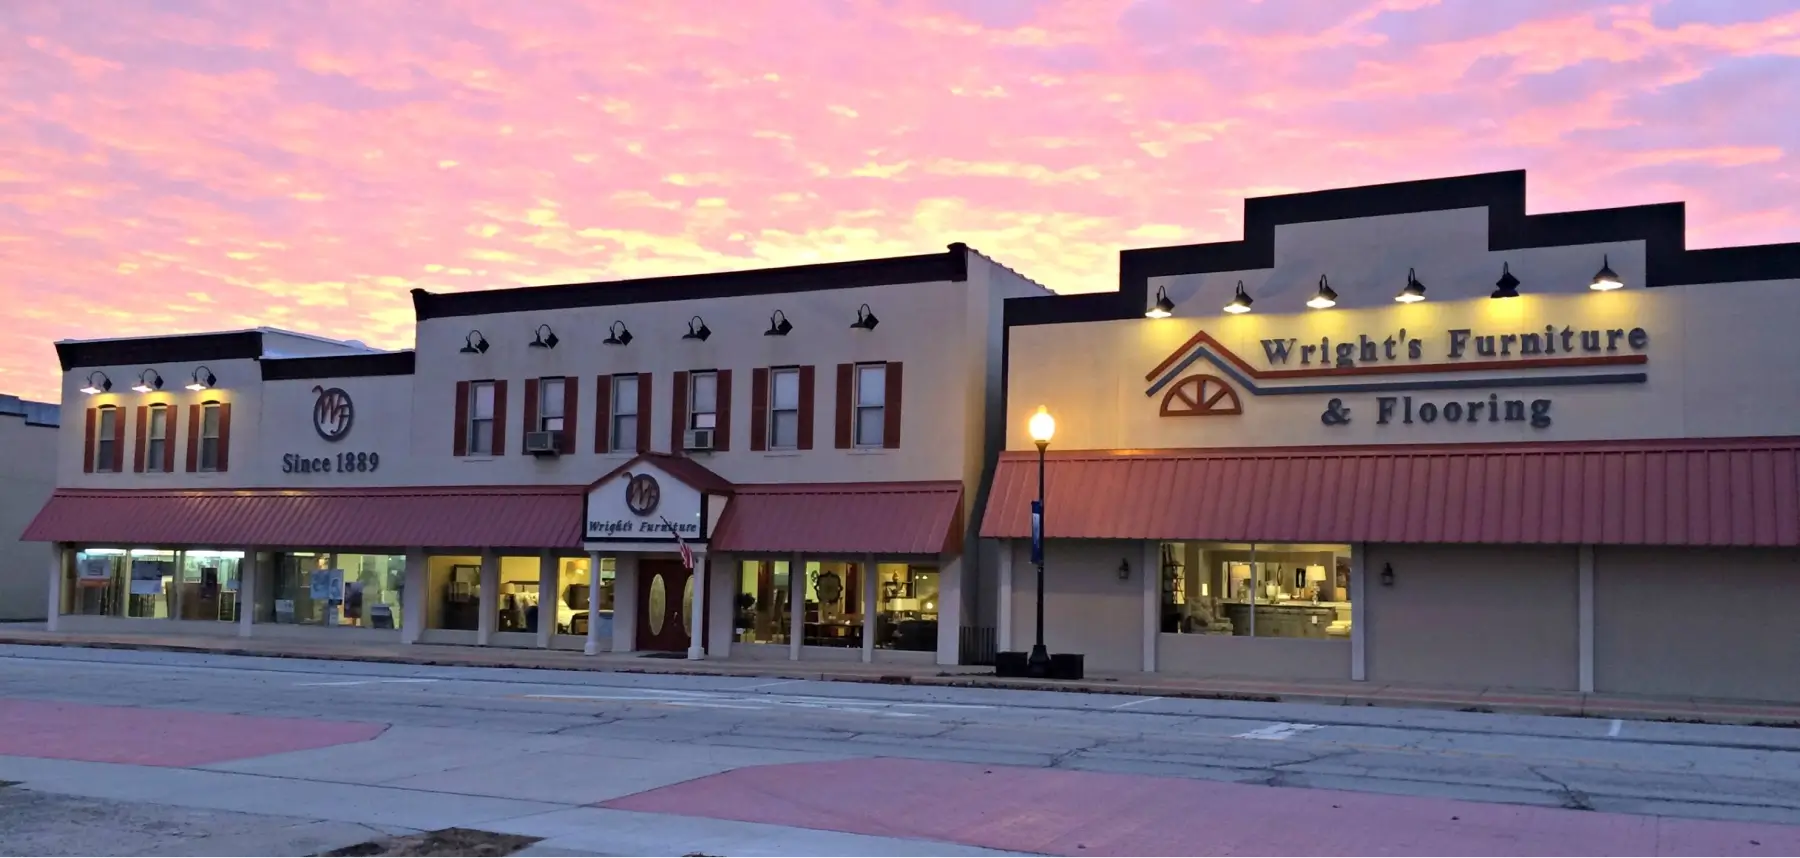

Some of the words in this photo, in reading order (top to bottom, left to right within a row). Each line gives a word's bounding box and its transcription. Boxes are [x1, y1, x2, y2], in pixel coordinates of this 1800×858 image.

[1260, 328, 1422, 368] Wright's
[1447, 324, 1648, 357] Furniture
[1321, 398, 1351, 425] &
[1376, 393, 1552, 428] Flooring
[282, 453, 330, 473] Since
[336, 452, 379, 473] 1889
[589, 520, 633, 536] Wright's
[639, 521, 697, 533] Furniture
